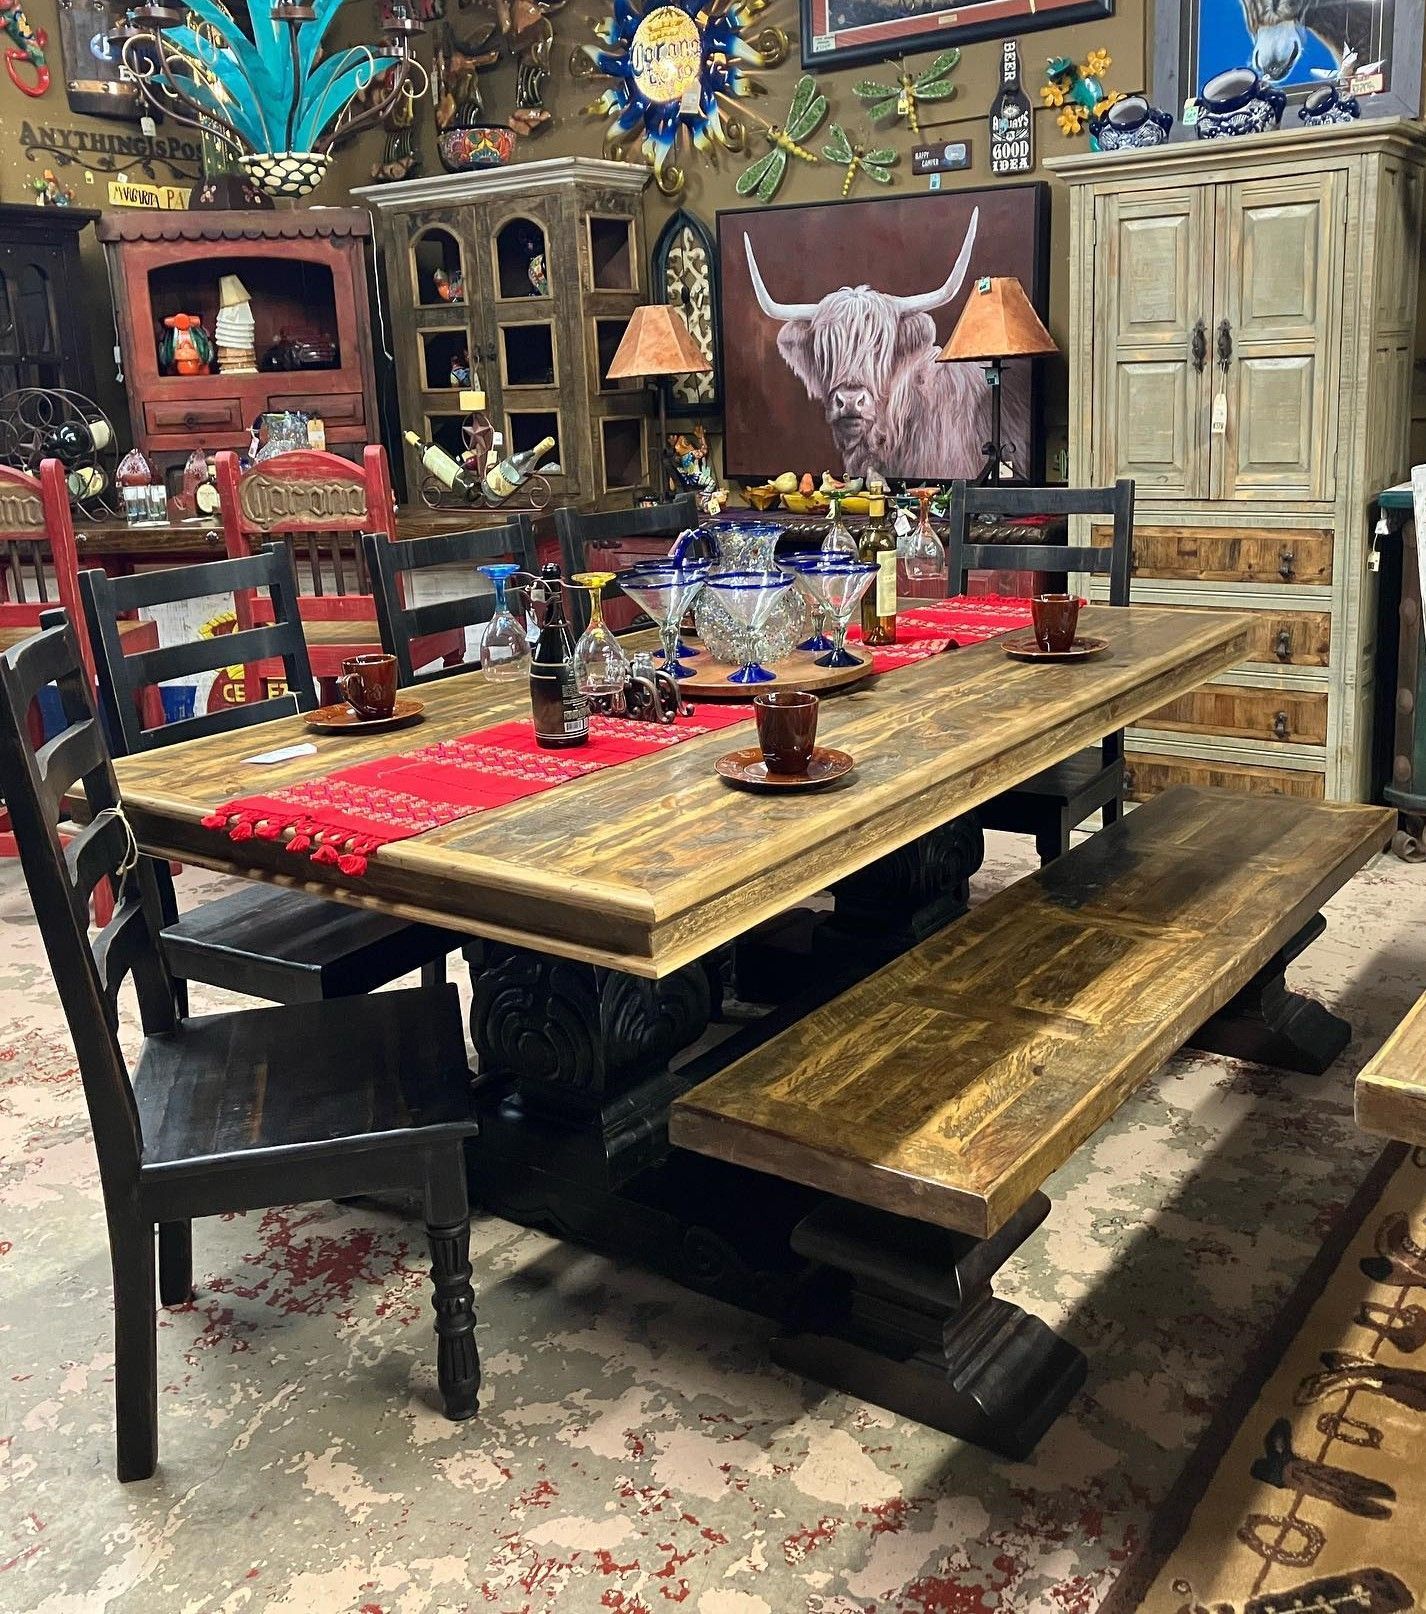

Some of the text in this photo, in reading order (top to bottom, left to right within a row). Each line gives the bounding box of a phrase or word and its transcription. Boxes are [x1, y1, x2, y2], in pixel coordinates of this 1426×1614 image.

[1004, 41, 1016, 82] BEER
[993, 140, 1029, 160] GOOD
[245, 474, 368, 530] Corona
